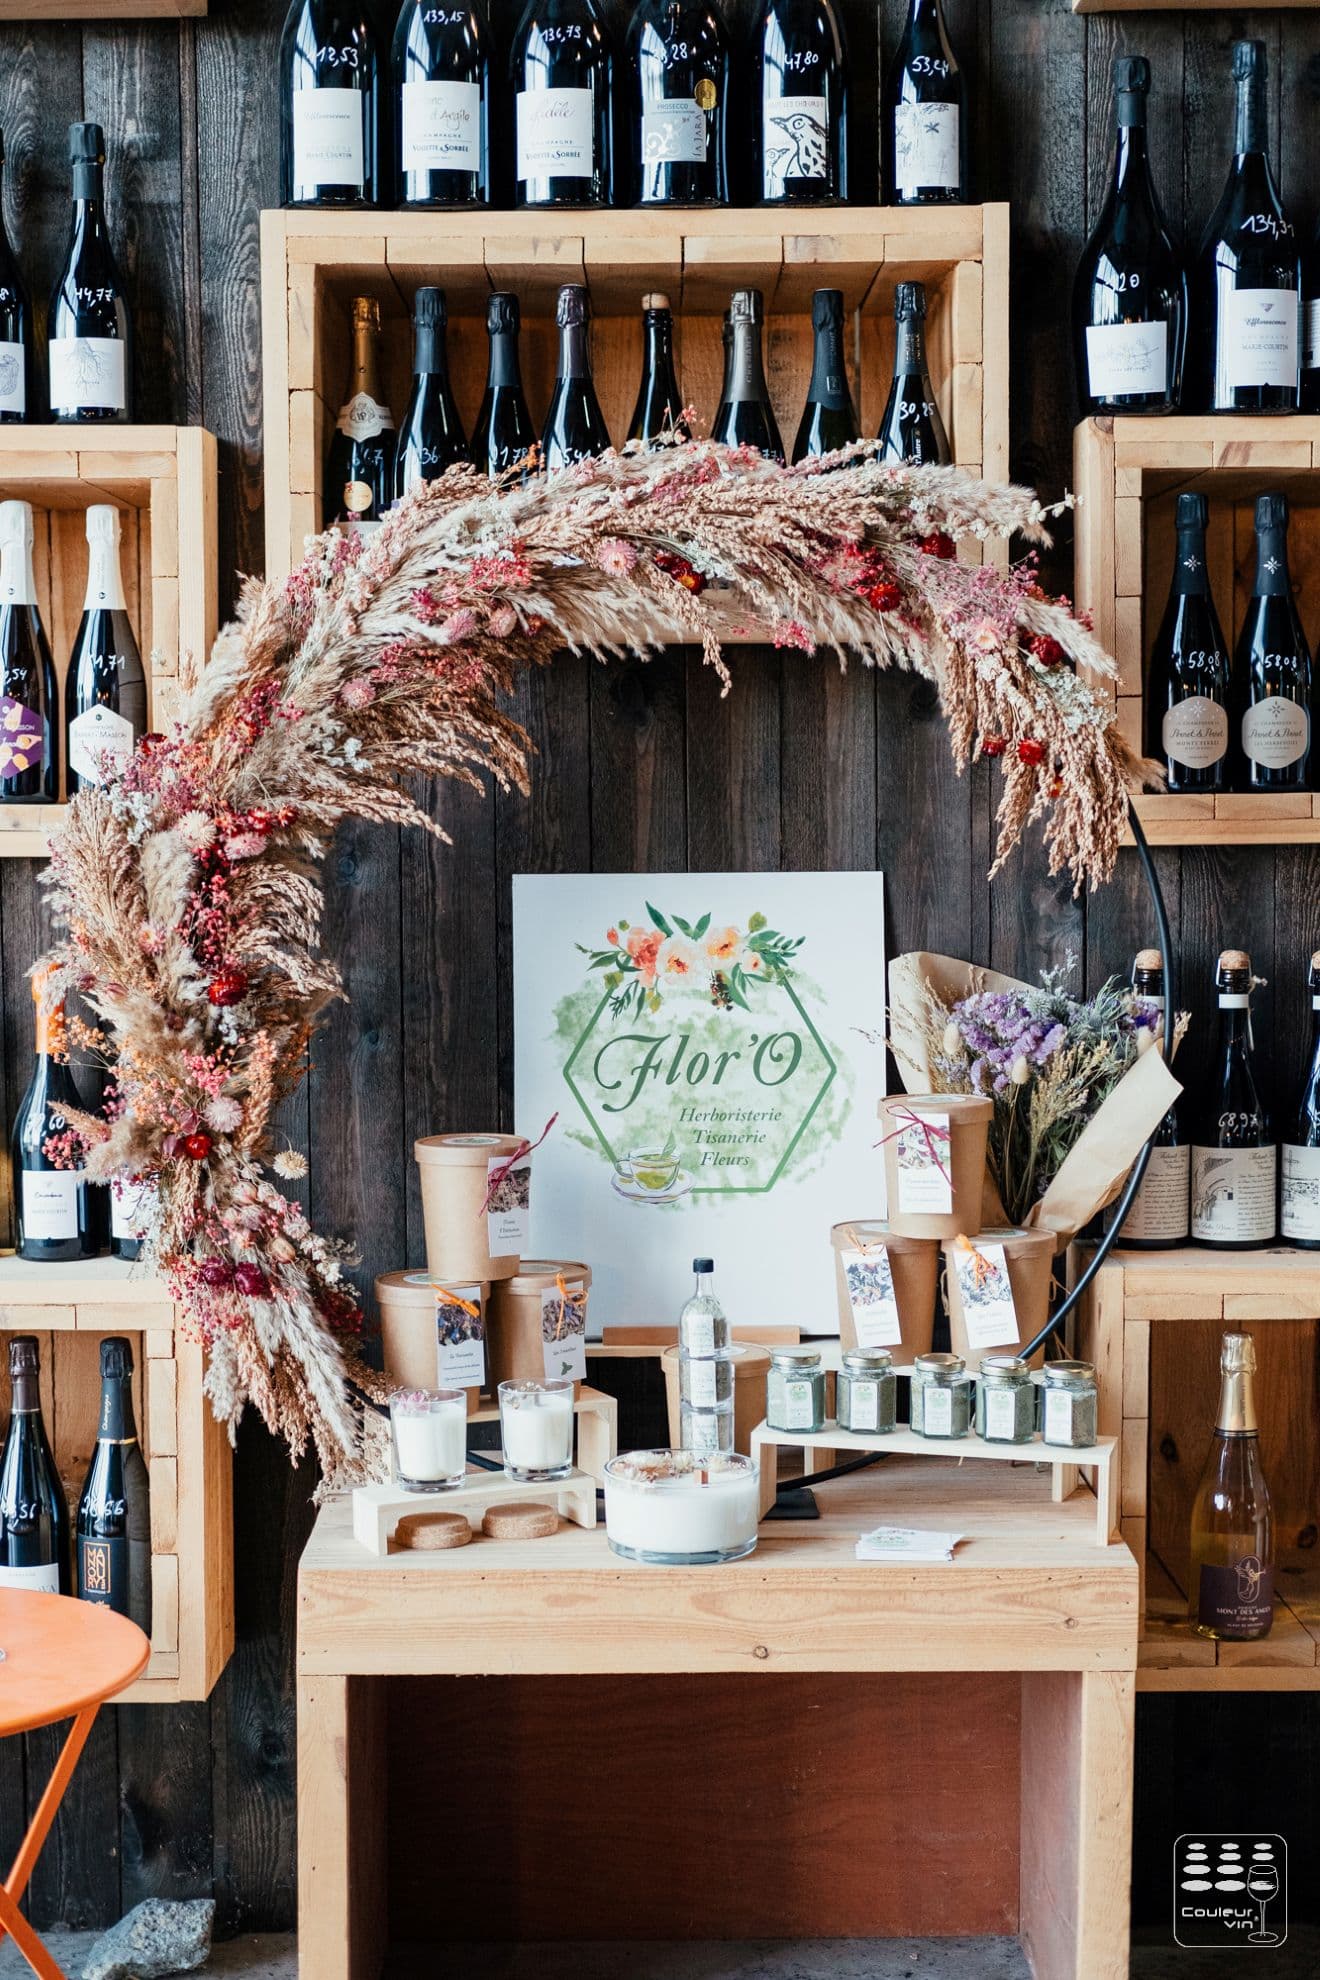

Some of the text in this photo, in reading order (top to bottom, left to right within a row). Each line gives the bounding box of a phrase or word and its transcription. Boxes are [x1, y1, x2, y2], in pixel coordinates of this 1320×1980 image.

[784, 51, 819, 73] 47,80
[1188, 651, 1220, 672] 58,08
[1264, 654, 1298, 671] 58,08
[593, 1031, 803, 1113] Flor'O
[679, 1107, 784, 1123] Herboristerie
[692, 1129, 767, 1145] Tisanerie
[699, 1151, 751, 1167] Fleurs
